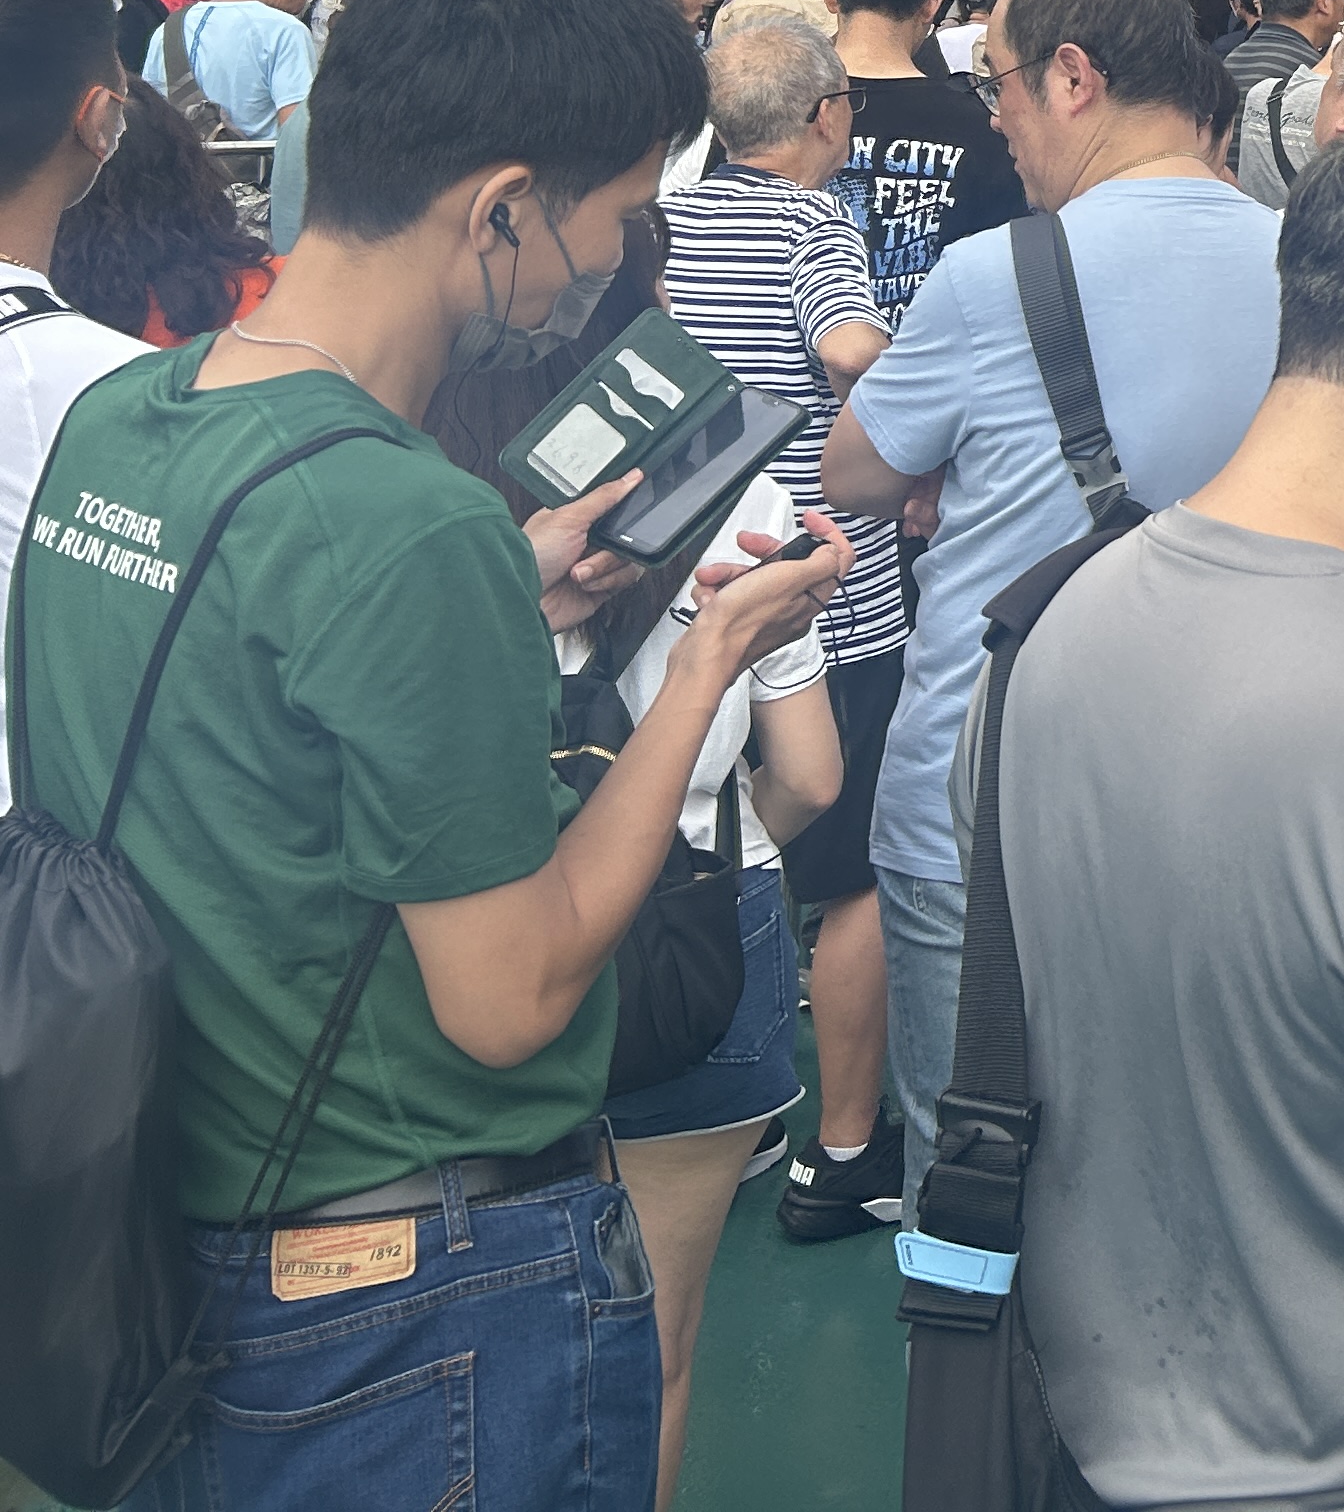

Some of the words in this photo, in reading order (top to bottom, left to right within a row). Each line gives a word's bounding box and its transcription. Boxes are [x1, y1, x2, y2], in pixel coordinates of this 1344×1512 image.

[843, 137, 876, 170] N
[884, 139, 965, 179] CITY
[873, 176, 956, 216] FEEL
[881, 205, 941, 249] THE
[74, 491, 162, 553] TOGETHER,
[32, 513, 61, 549] WE
[56, 526, 105, 567] RUN
[101, 543, 178, 594] FURTHER
[278, 1263, 296, 1275] LOT
[370, 1244, 401, 1262] 1892
